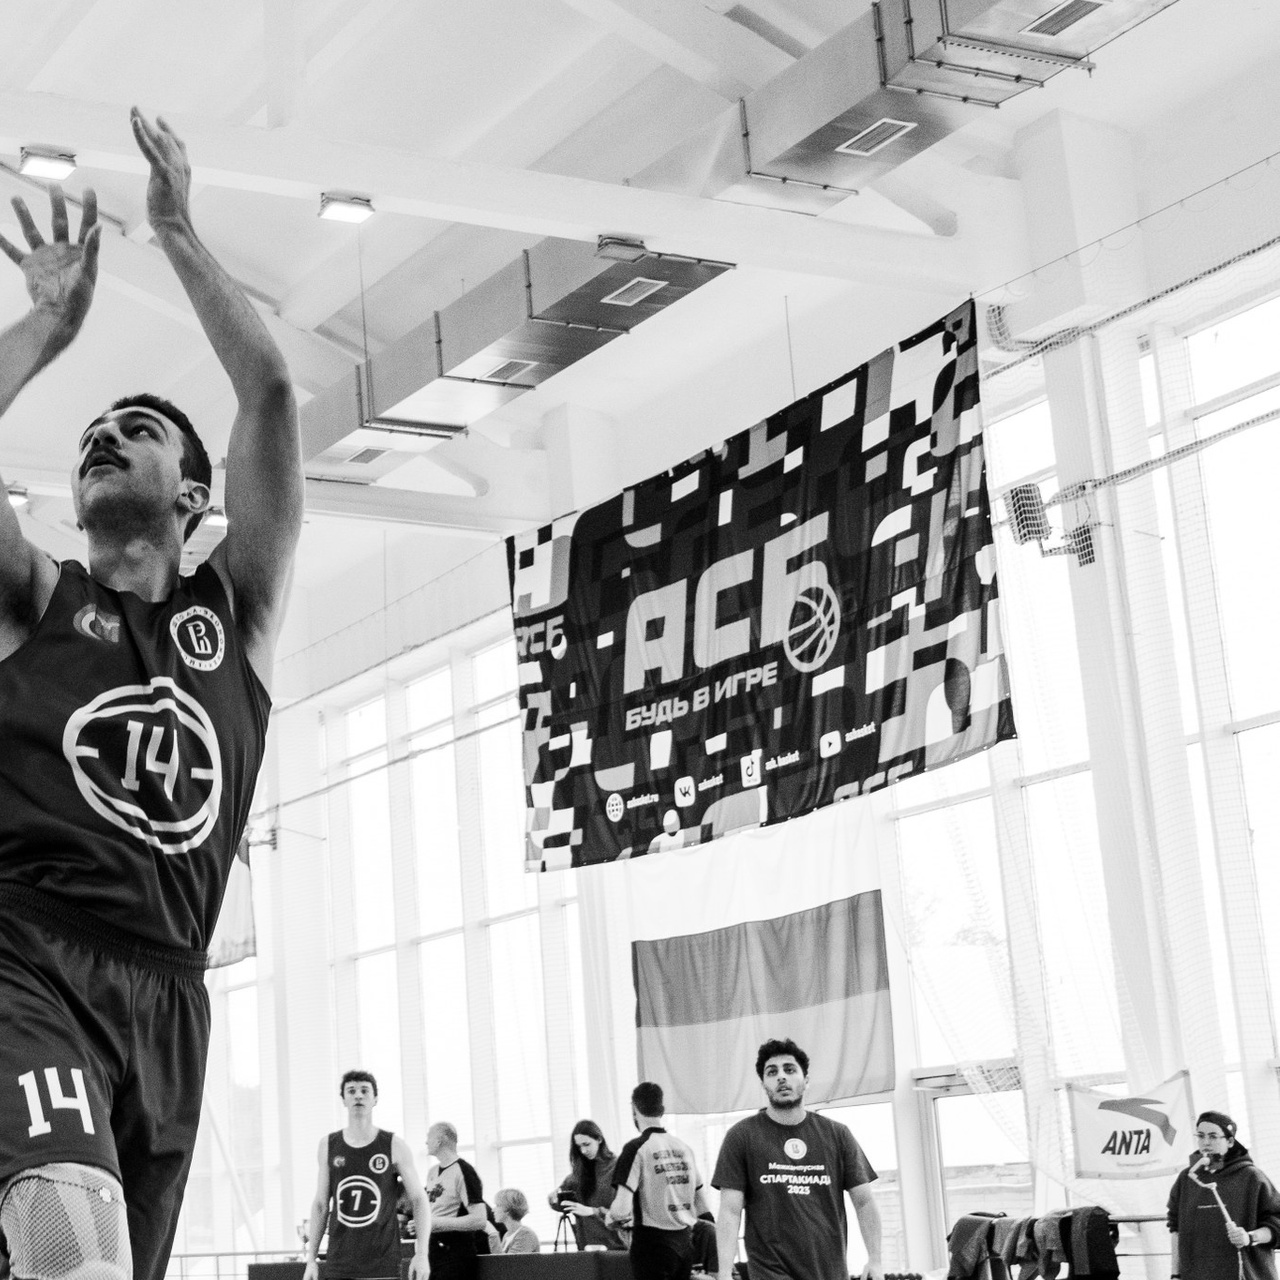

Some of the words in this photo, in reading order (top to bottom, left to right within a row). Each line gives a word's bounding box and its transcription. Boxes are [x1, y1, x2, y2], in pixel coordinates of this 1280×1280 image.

[623, 511, 841, 695] АСБ
[625, 696, 690, 731] БУДЬ
[692, 686, 710, 712] В
[714, 661, 778, 703] ИГРЕ
[120, 719, 180, 802] 14
[18, 1066, 96, 1138] 14
[1100, 1128, 1152, 1156] ANTA
[350, 1189, 363, 1212] 7
[786, 1184, 811, 1195] 2023
